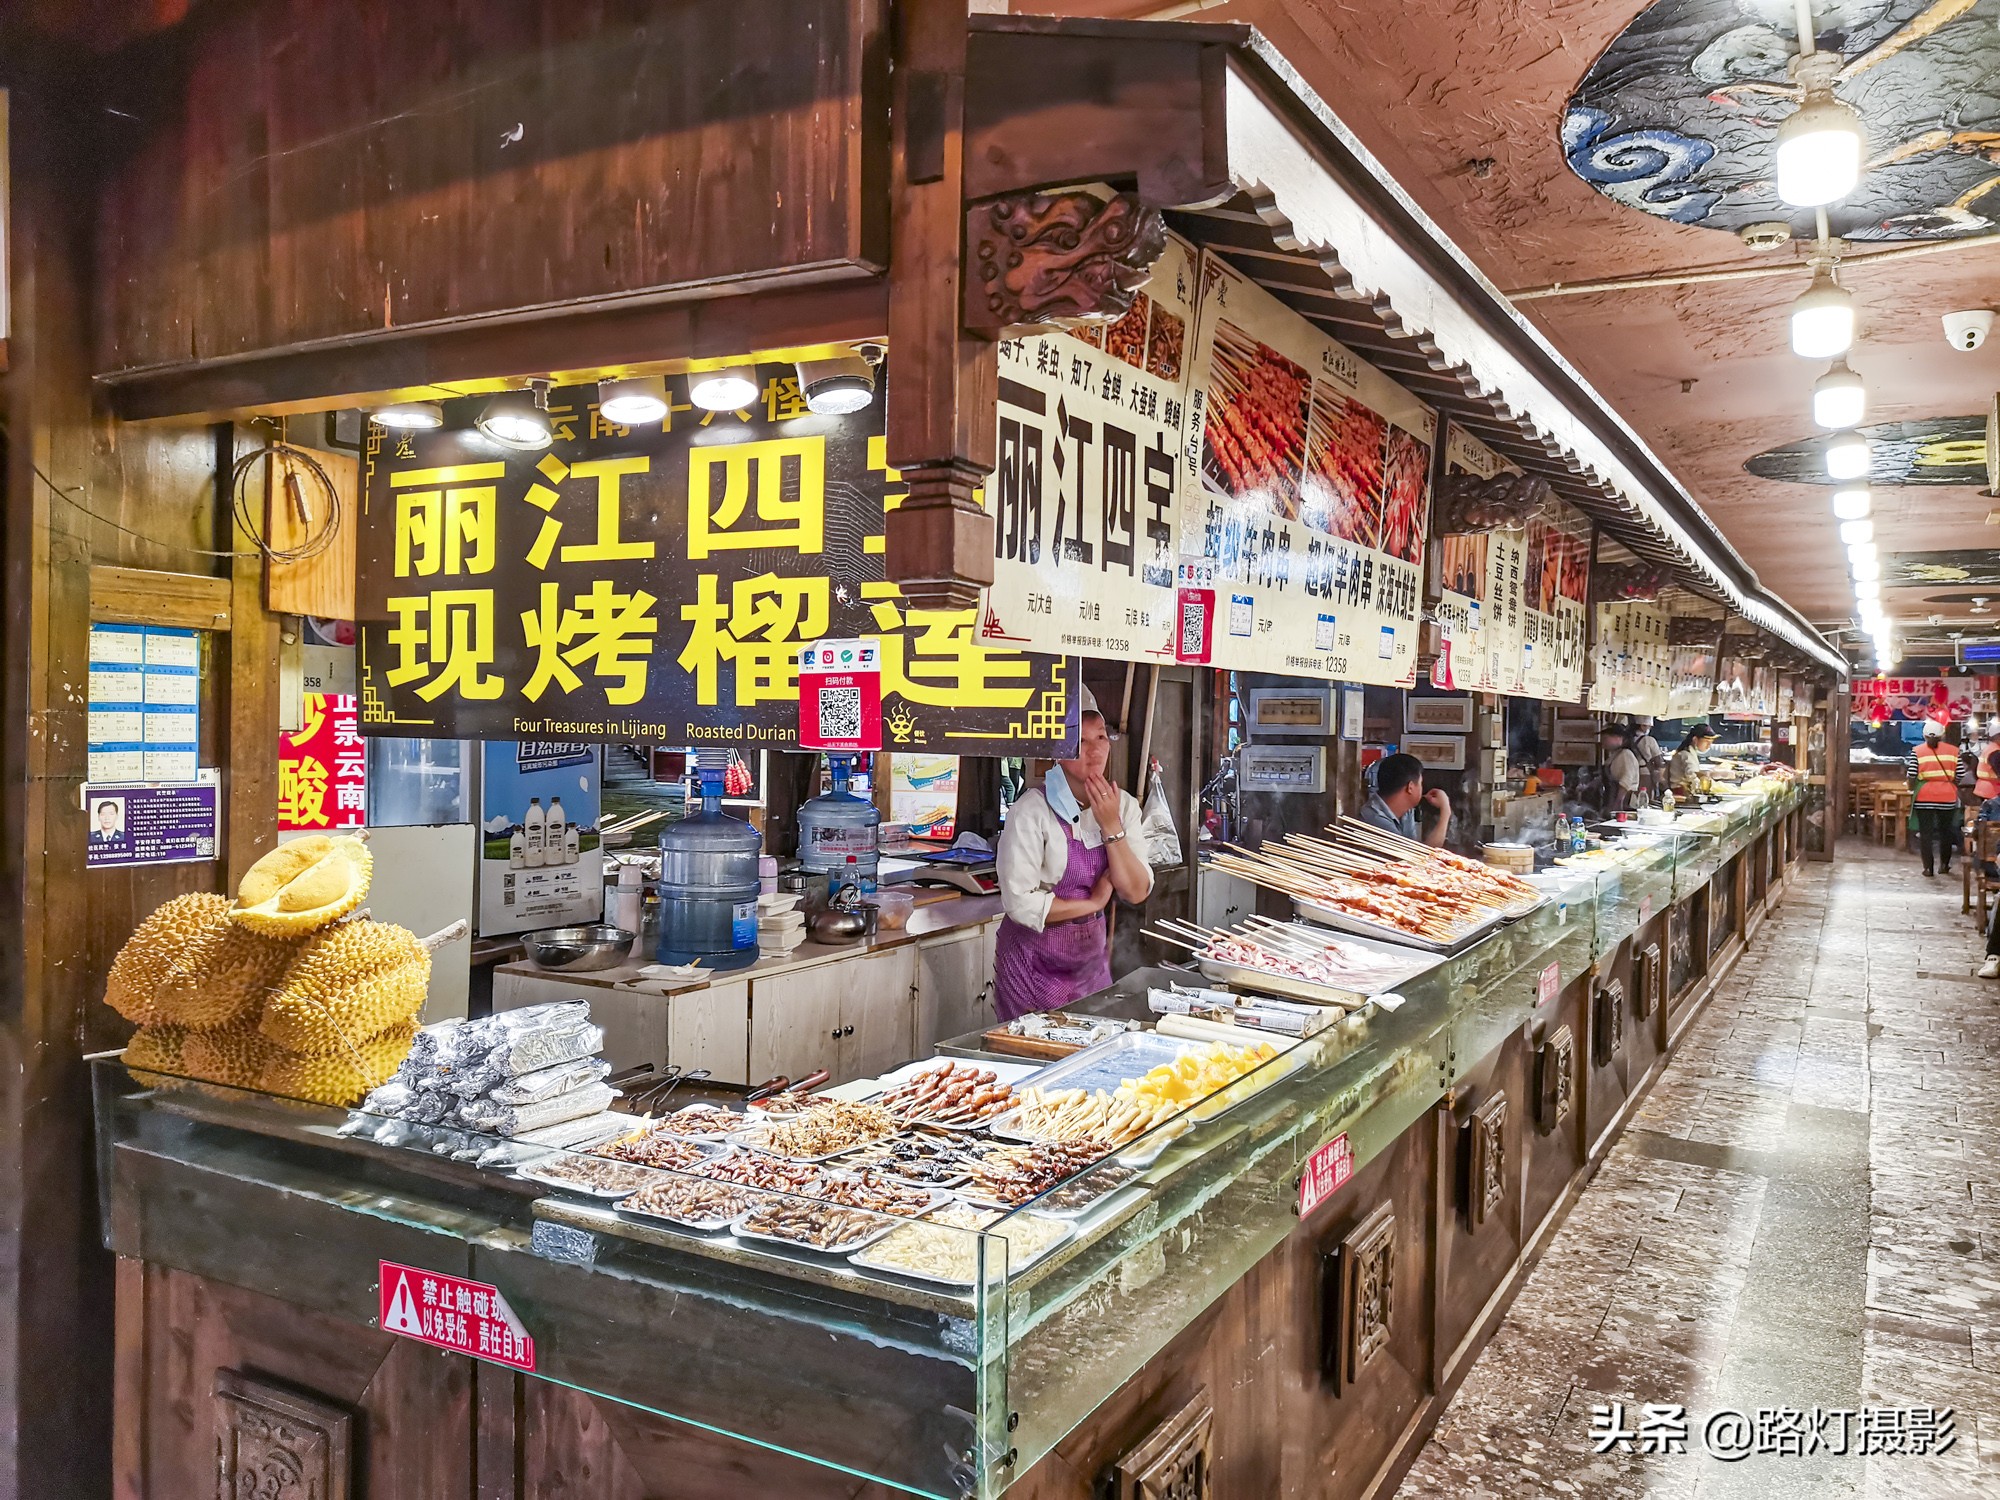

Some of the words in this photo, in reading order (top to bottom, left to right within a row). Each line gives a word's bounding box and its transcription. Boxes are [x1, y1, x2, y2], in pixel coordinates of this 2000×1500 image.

[995, 376, 1174, 589] 丽江四宝
[386, 435, 904, 578] 丽江四
[1304, 536, 1373, 610] 超级羊肉串
[1027, 592, 1052, 615] 元/大盘
[1078, 600, 1100, 621] 元/小盘
[1105, 637, 1130, 652] 12358
[1325, 656, 1347, 675] 12358
[825, 676, 854, 686] 扫码付款
[513, 717, 542, 733] Four
[543, 718, 604, 735] Treasures
[606, 719, 618, 734] in
[621, 720, 666, 740] Lijiang
[686, 722, 743, 740] Roasted
[746, 723, 797, 741] Durian
